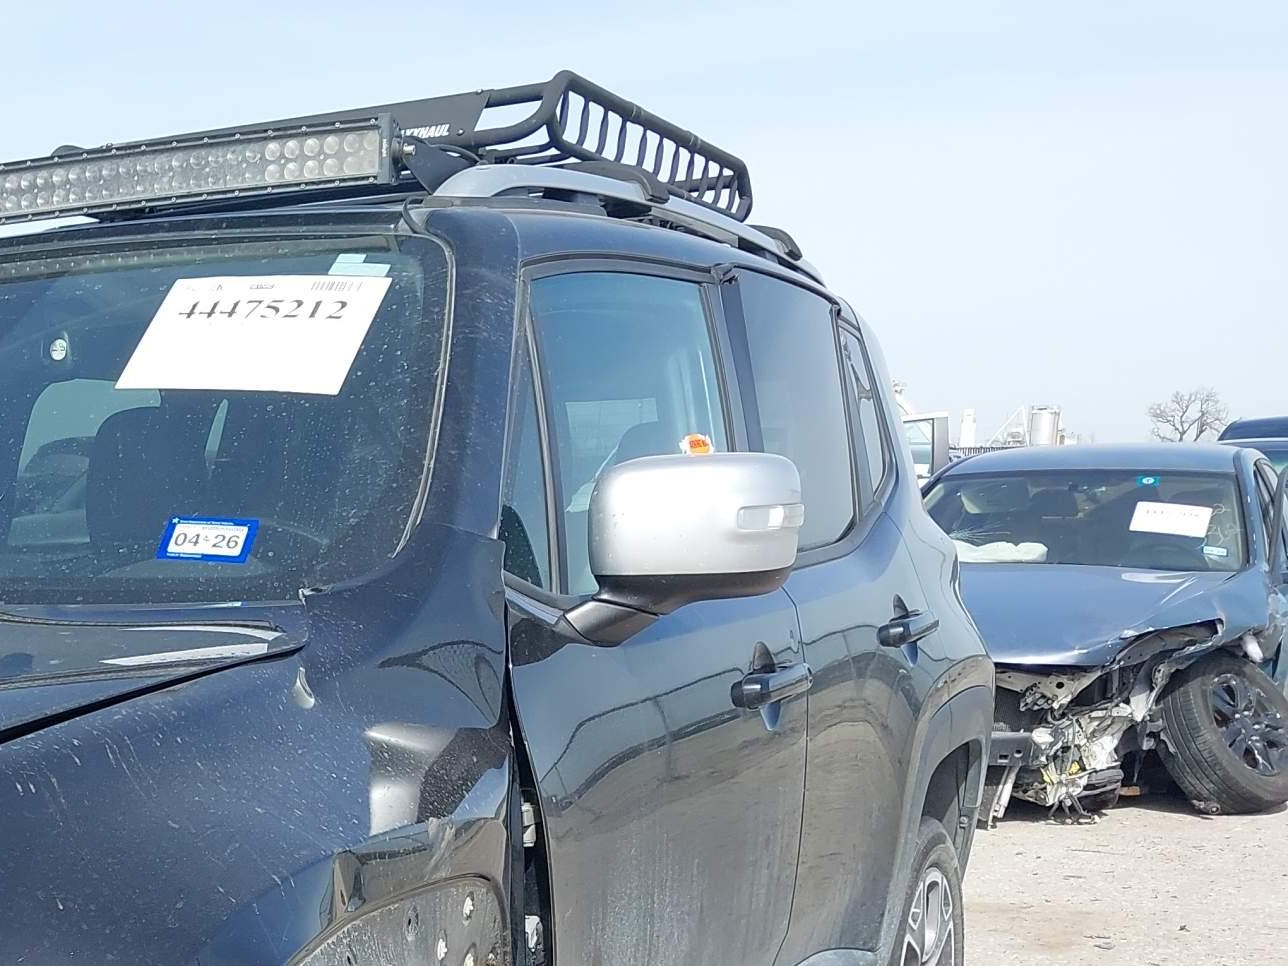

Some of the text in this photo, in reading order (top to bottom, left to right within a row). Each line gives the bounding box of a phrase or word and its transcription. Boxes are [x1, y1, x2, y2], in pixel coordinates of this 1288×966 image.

[178, 300, 348, 319] 44475212
[174, 532, 240, 549] 04 26
